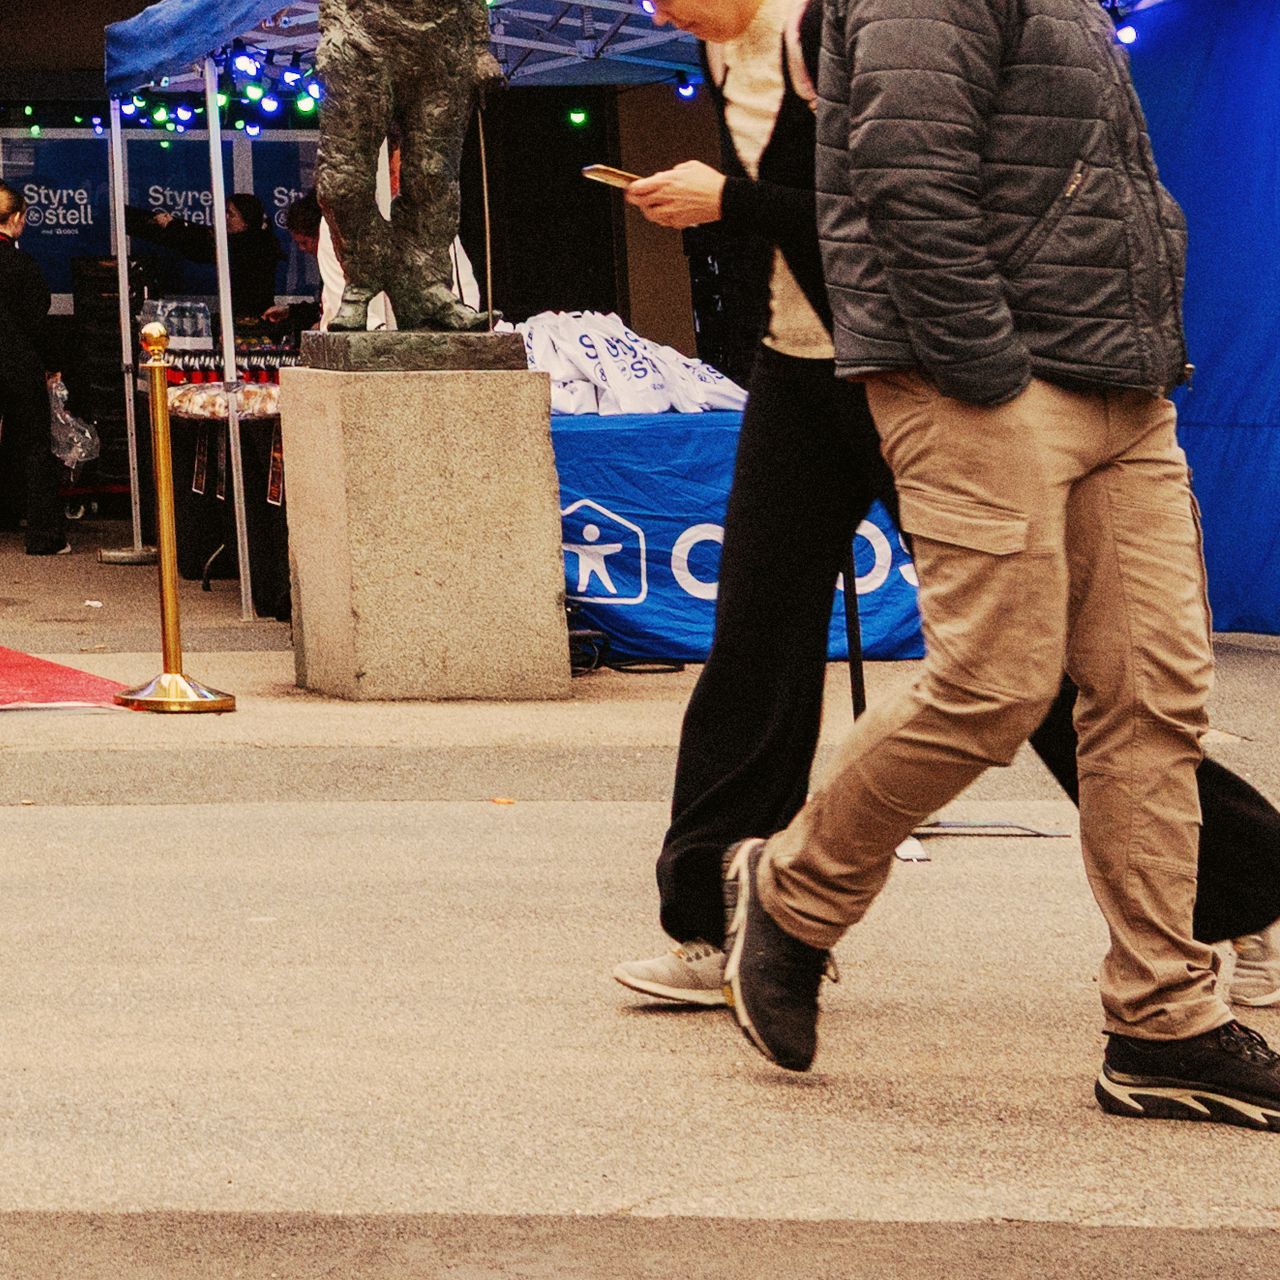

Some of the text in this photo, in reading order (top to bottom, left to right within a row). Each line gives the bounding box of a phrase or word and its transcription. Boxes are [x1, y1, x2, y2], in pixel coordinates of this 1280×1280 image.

[23, 184, 88, 209] Styre
[148, 185, 213, 210] Styre
[44, 204, 94, 225] stell
